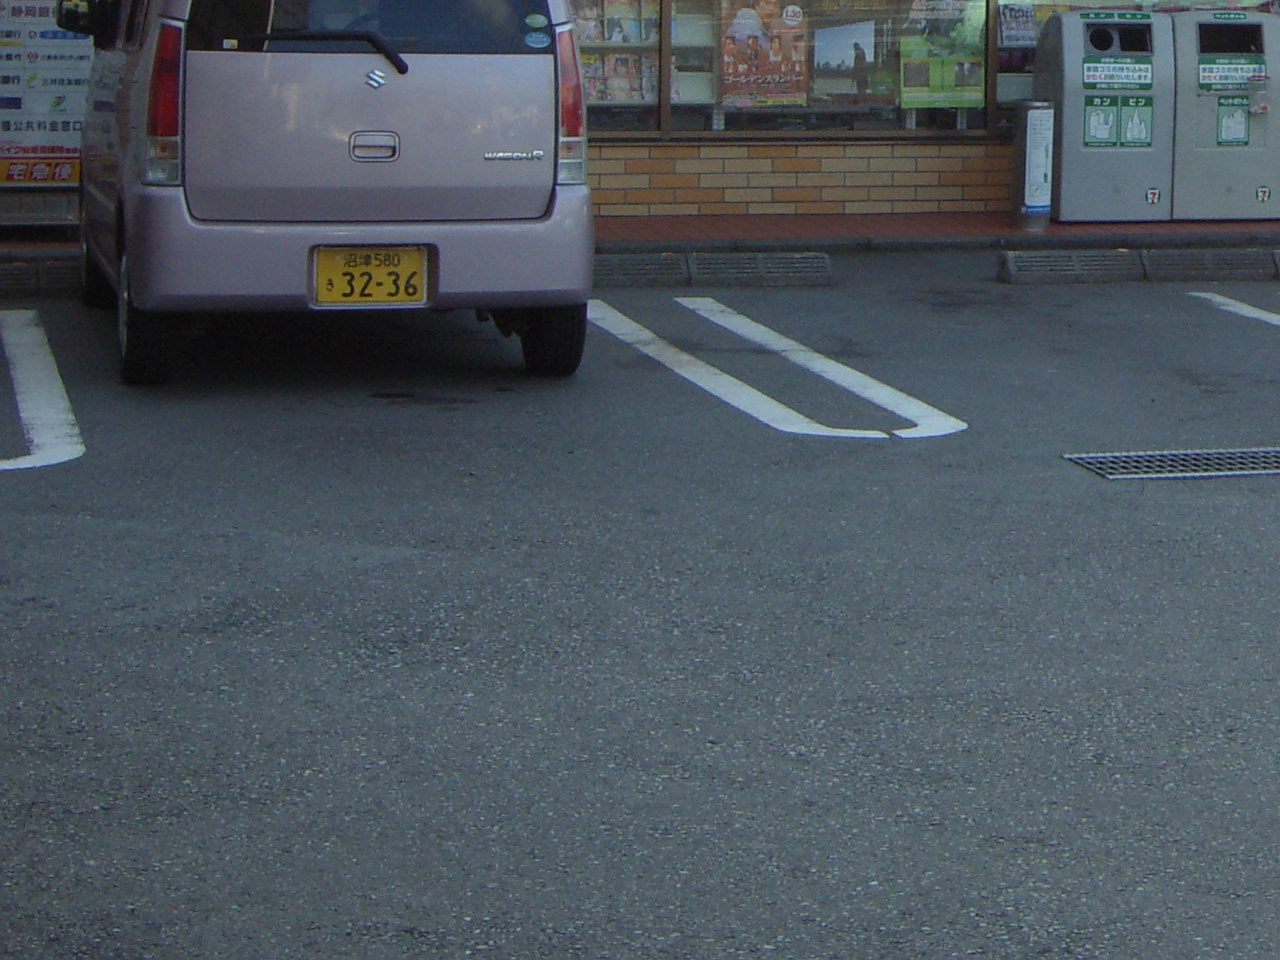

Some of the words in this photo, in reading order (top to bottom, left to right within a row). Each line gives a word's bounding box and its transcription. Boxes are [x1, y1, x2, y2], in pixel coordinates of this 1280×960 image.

[11, 6, 57, 17] 静岡銀
[1093, 97, 1110, 105] カン
[8, 162, 74, 180] 宅急便
[342, 271, 418, 297] 32-36
